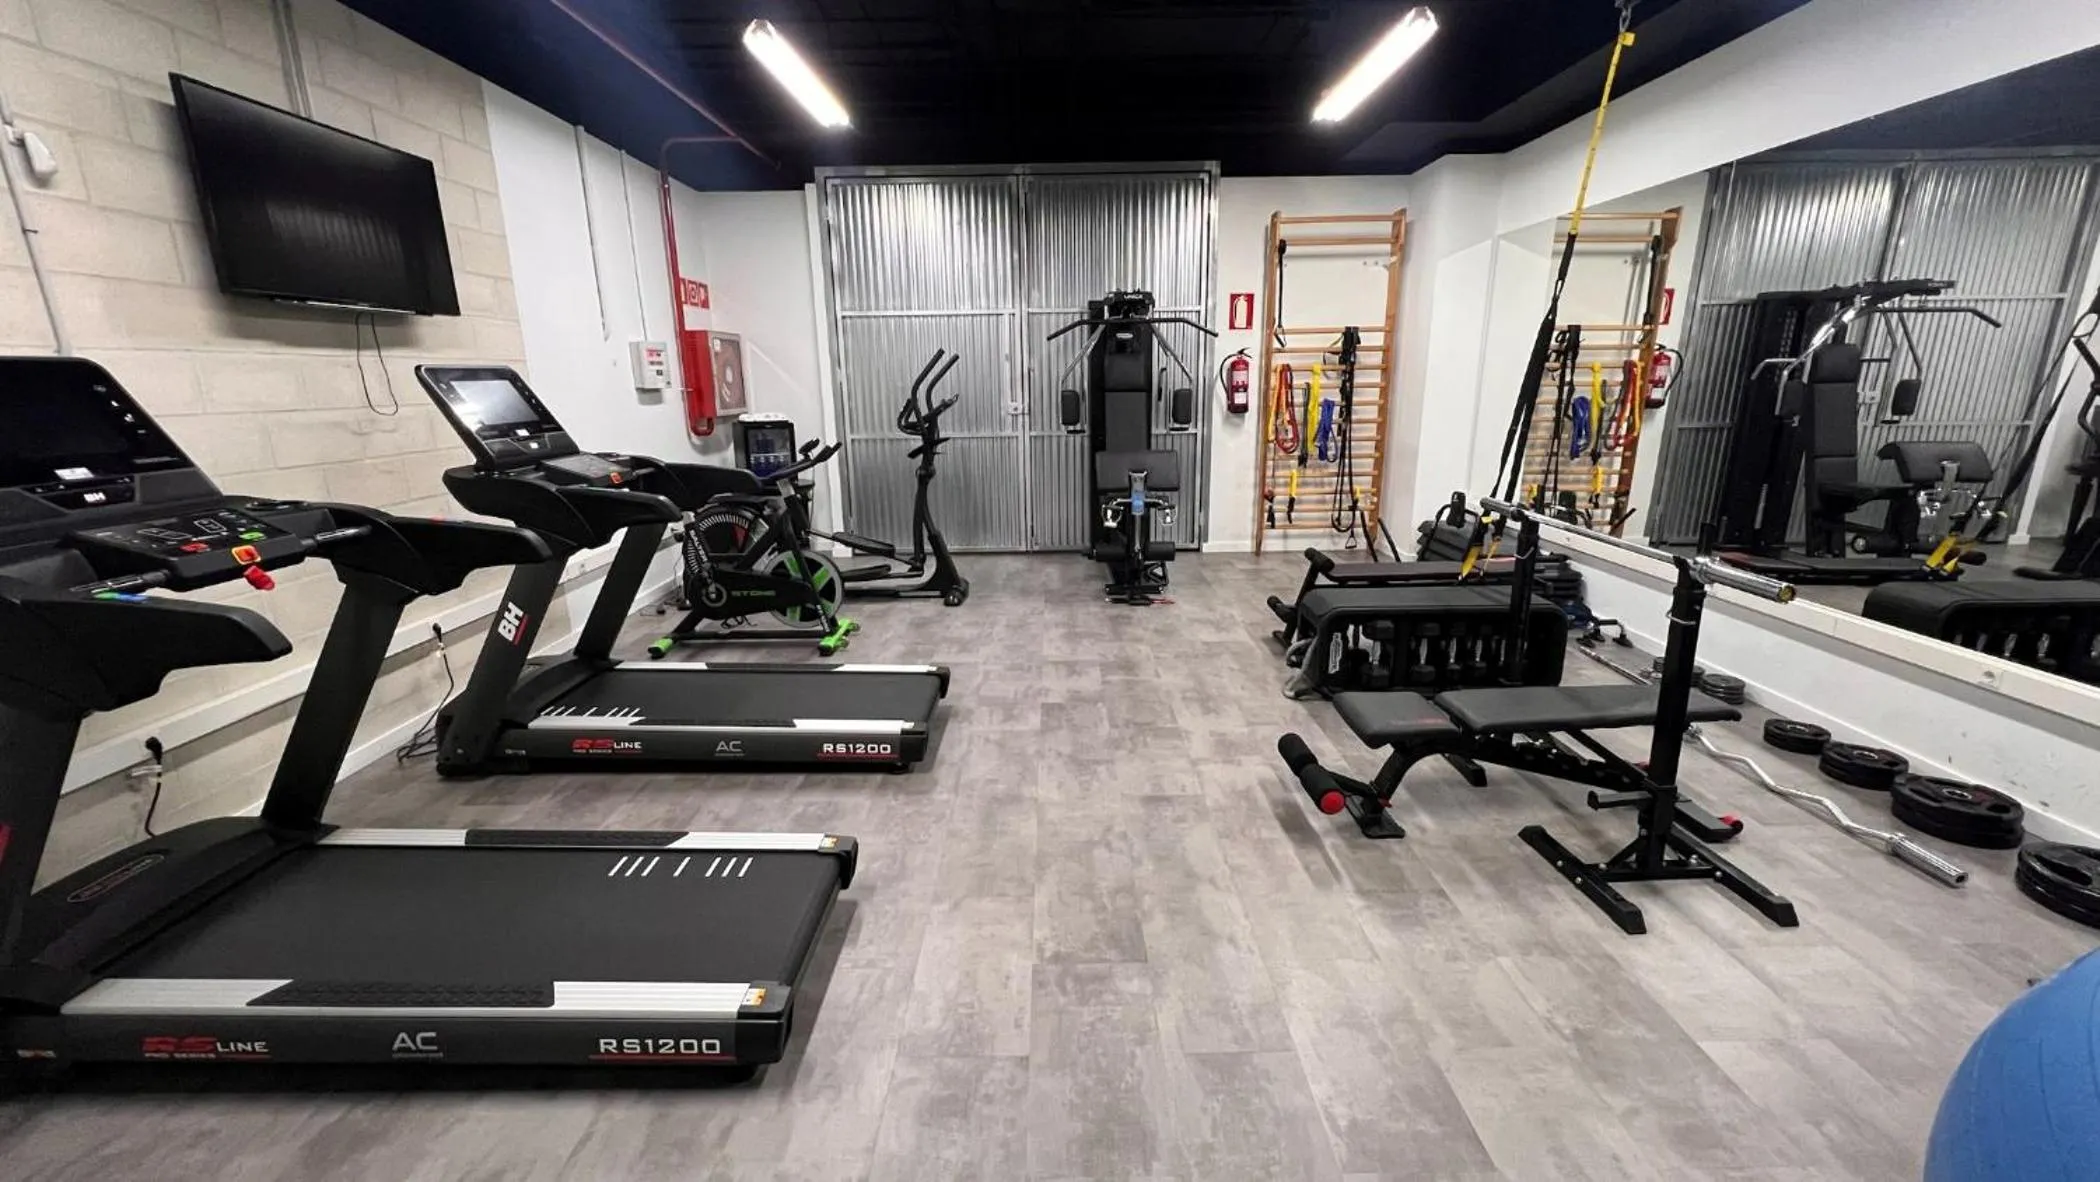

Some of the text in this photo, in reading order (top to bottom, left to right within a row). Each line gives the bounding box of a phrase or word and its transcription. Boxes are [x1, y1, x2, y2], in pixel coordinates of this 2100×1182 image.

[498, 601, 524, 642] BH
[613, 741, 642, 749] LINE
[716, 740, 742, 752] AC
[823, 742, 891, 754] RS1200
[216, 1041, 269, 1053] LINE
[391, 1031, 439, 1051] AC
[599, 1038, 721, 1054] RS1200
